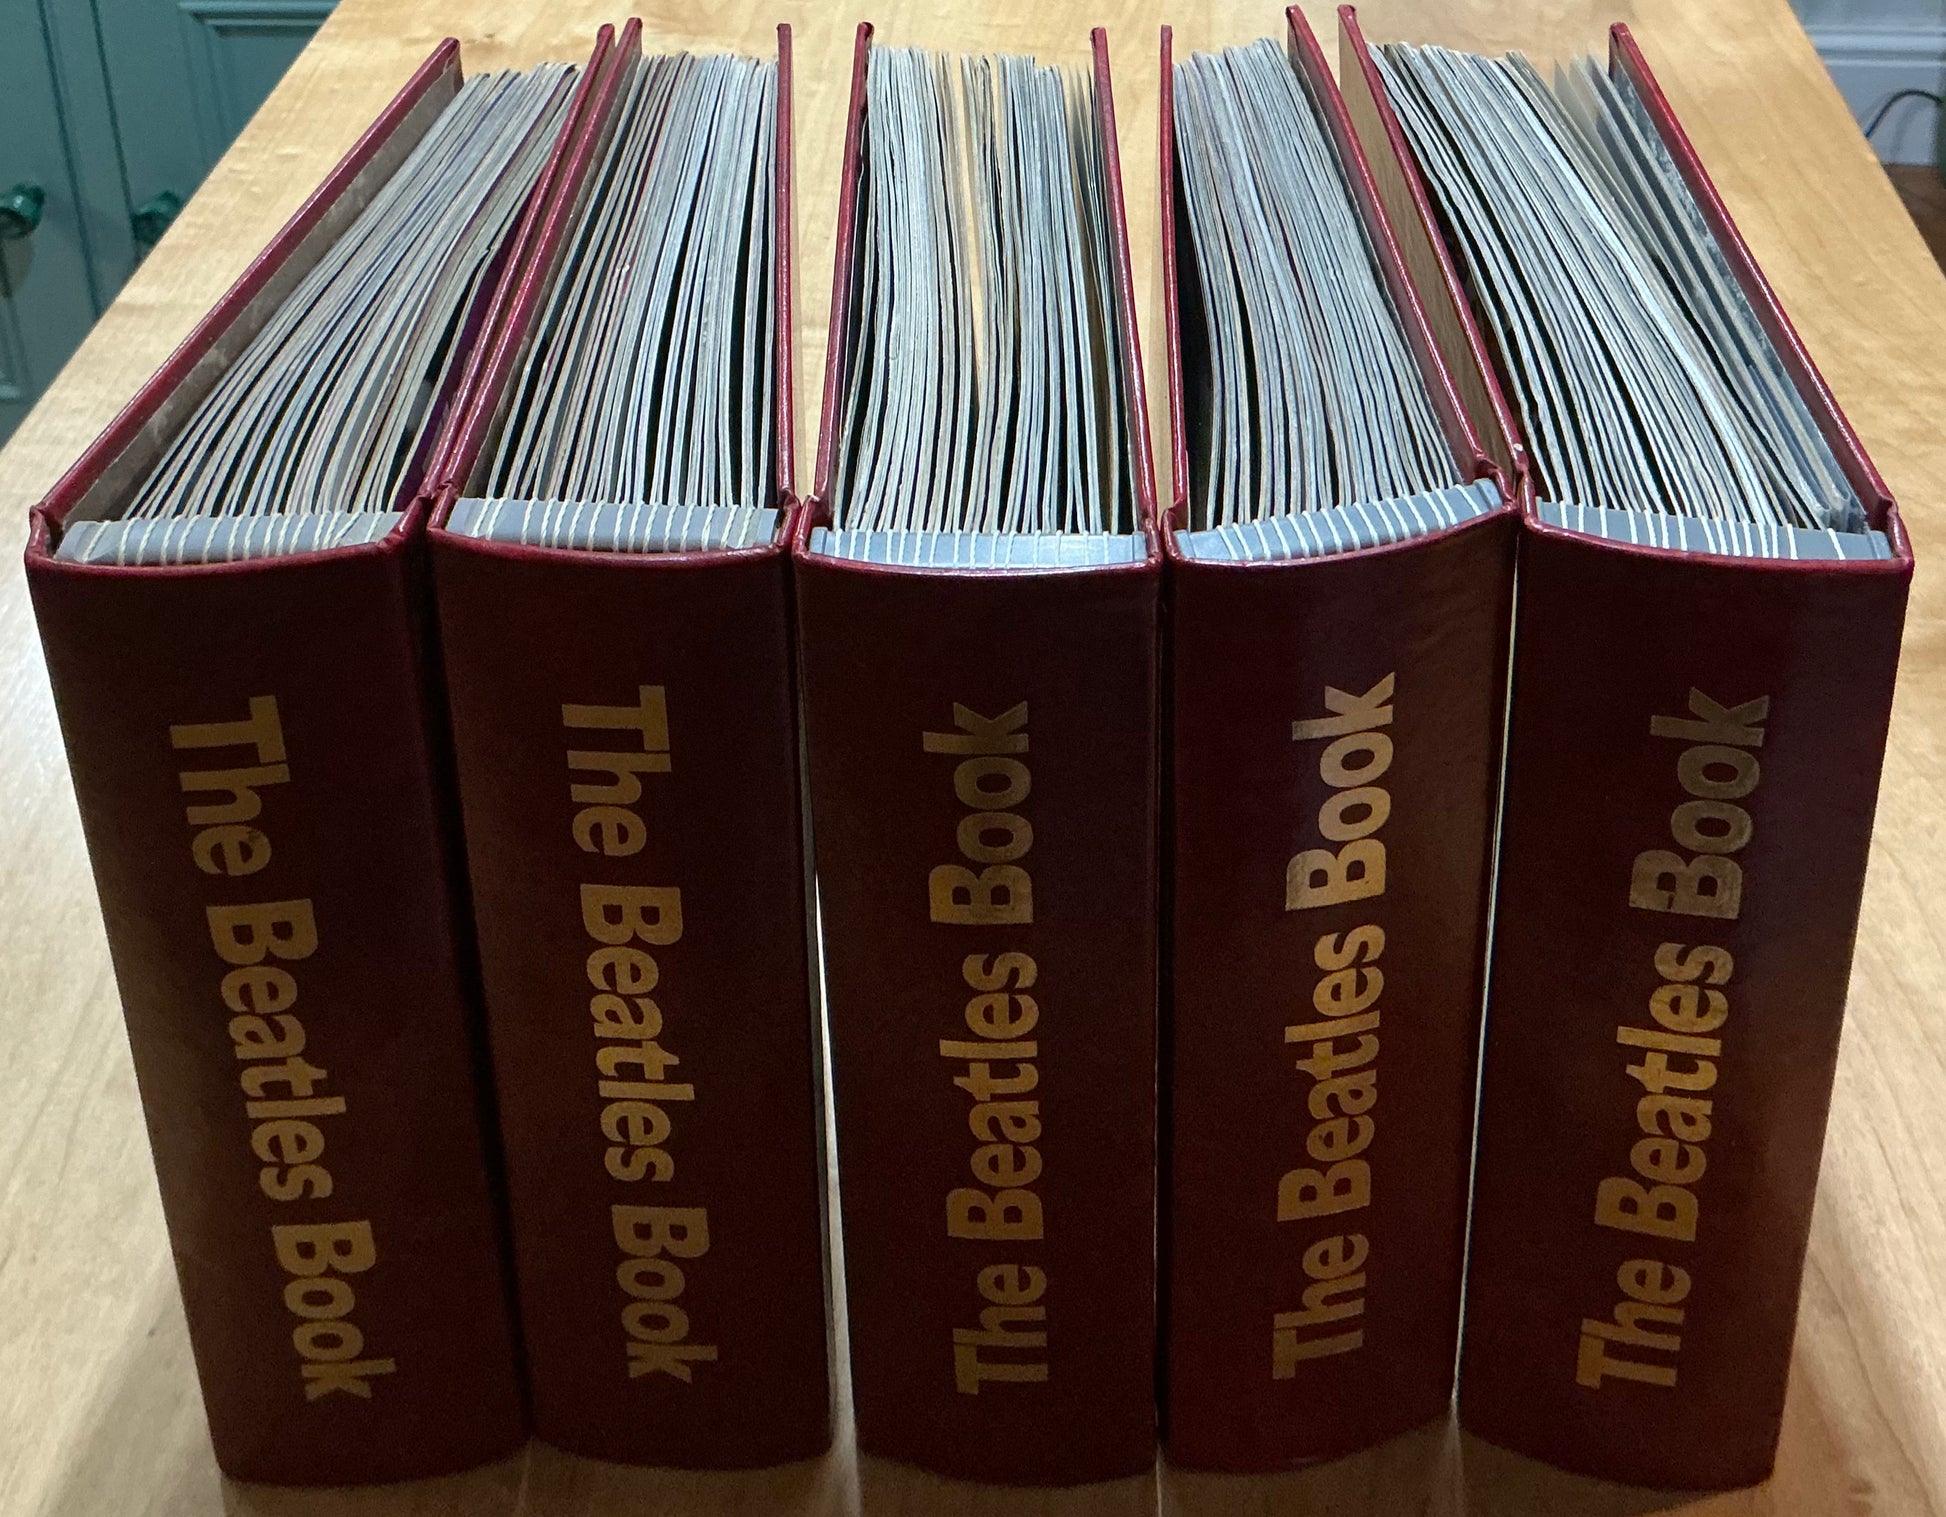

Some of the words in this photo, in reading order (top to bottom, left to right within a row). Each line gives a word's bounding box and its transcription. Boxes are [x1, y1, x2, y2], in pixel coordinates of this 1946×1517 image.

[170, 695, 290, 876] The
[562, 685, 671, 856] The
[923, 701, 1034, 925] Book
[1286, 672, 1395, 910] Book
[1629, 687, 1769, 919] Book
[206, 899, 346, 1201] Beatles
[580, 884, 695, 1181] Beatles
[939, 952, 1043, 1240] Beatles
[1278, 925, 1385, 1221] Beatles
[1595, 943, 1733, 1241] Beatles
[271, 1220, 395, 1400] Book
[611, 1204, 717, 1382] Book
[953, 1264, 1048, 1395] The
[1273, 1233, 1369, 1379] The
[1576, 1259, 1691, 1388] The
